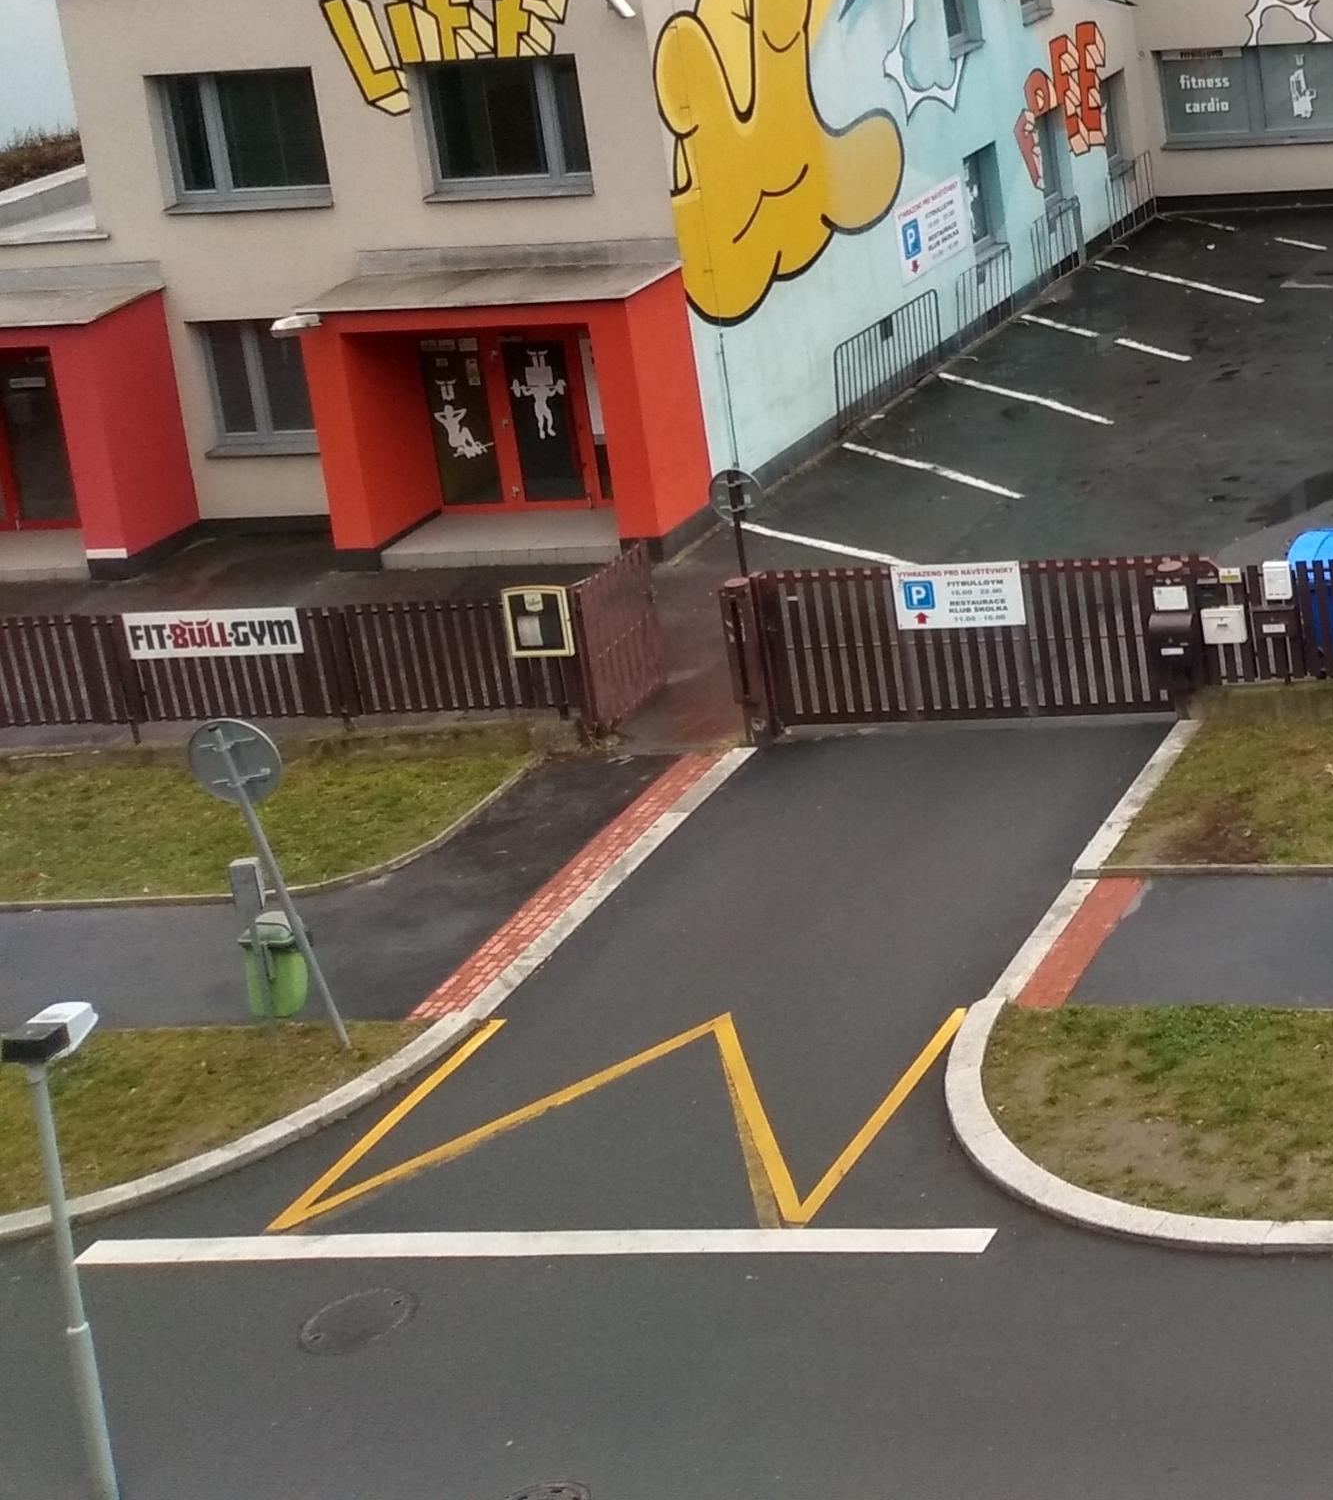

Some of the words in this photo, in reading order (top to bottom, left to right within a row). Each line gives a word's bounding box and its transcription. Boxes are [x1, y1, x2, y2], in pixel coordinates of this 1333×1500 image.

[1179, 74, 1230, 90] fitness
[1185, 97, 1230, 113] cardio
[906, 228, 916, 255] P
[896, 569, 943, 578] VYHRAZENO
[943, 569, 959, 577] PRO
[910, 585, 927, 606] P
[949, 598, 1007, 606] RESTAURACE
